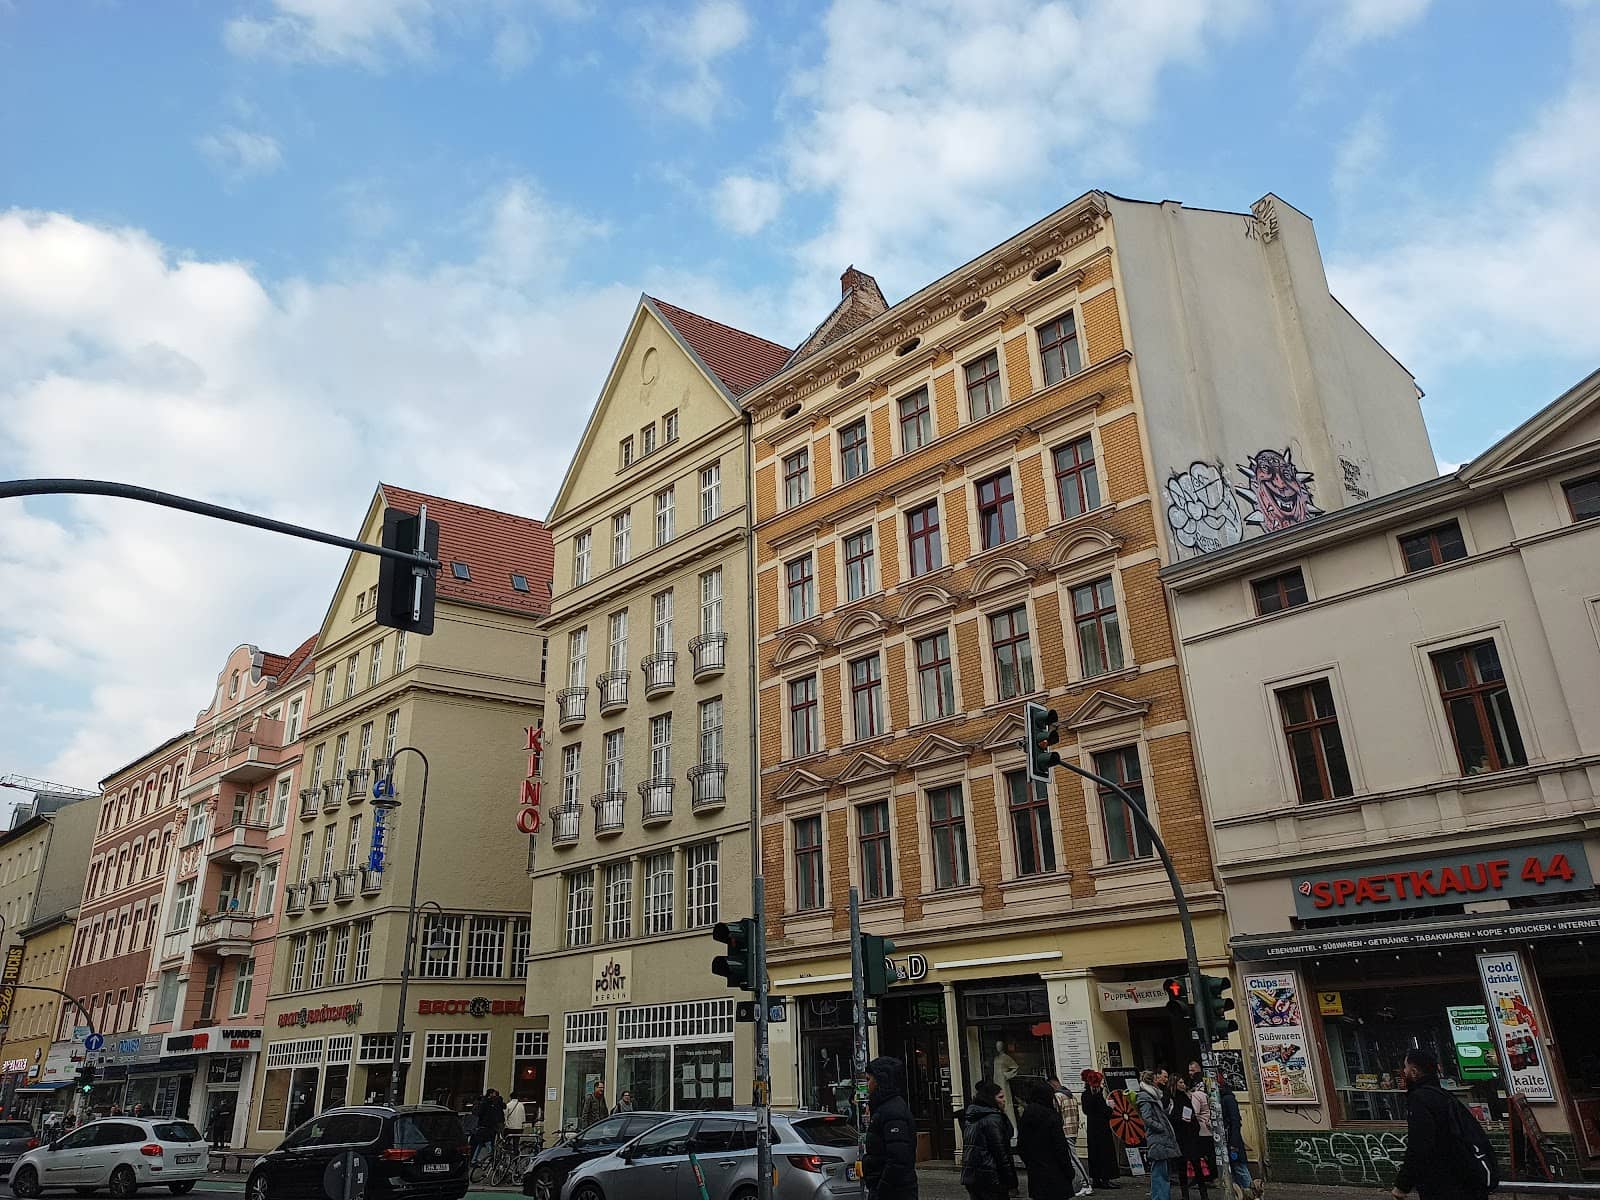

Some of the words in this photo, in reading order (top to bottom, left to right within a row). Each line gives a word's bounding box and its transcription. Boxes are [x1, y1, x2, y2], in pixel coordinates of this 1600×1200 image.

[516, 725, 544, 834] KINO
[1312, 859, 1510, 910] SPÆTKAUF
[1521, 853, 1576, 885] 44
[1266, 944, 1318, 956] LEBENSMITTEL
[1368, 935, 1410, 947] GETRÄNKE
[1414, 930, 1471, 943] TABAKWAREN
[1477, 927, 1503, 938] KOPIE
[1509, 923, 1551, 935] DRUCKEN
[4, 948, 23, 980] FUCHS
[601, 960, 621, 978] JOB
[1487, 961, 1515, 973] cold
[595, 975, 626, 992] POINT
[1249, 979, 1278, 989] Chips
[1487, 974, 1520, 984] drinks
[417, 999, 470, 1015] BROT
[222, 1029, 262, 1039] WUNDER
[1258, 1032, 1301, 1041] Süßwaren
[1512, 1075, 1545, 1086] kalte
